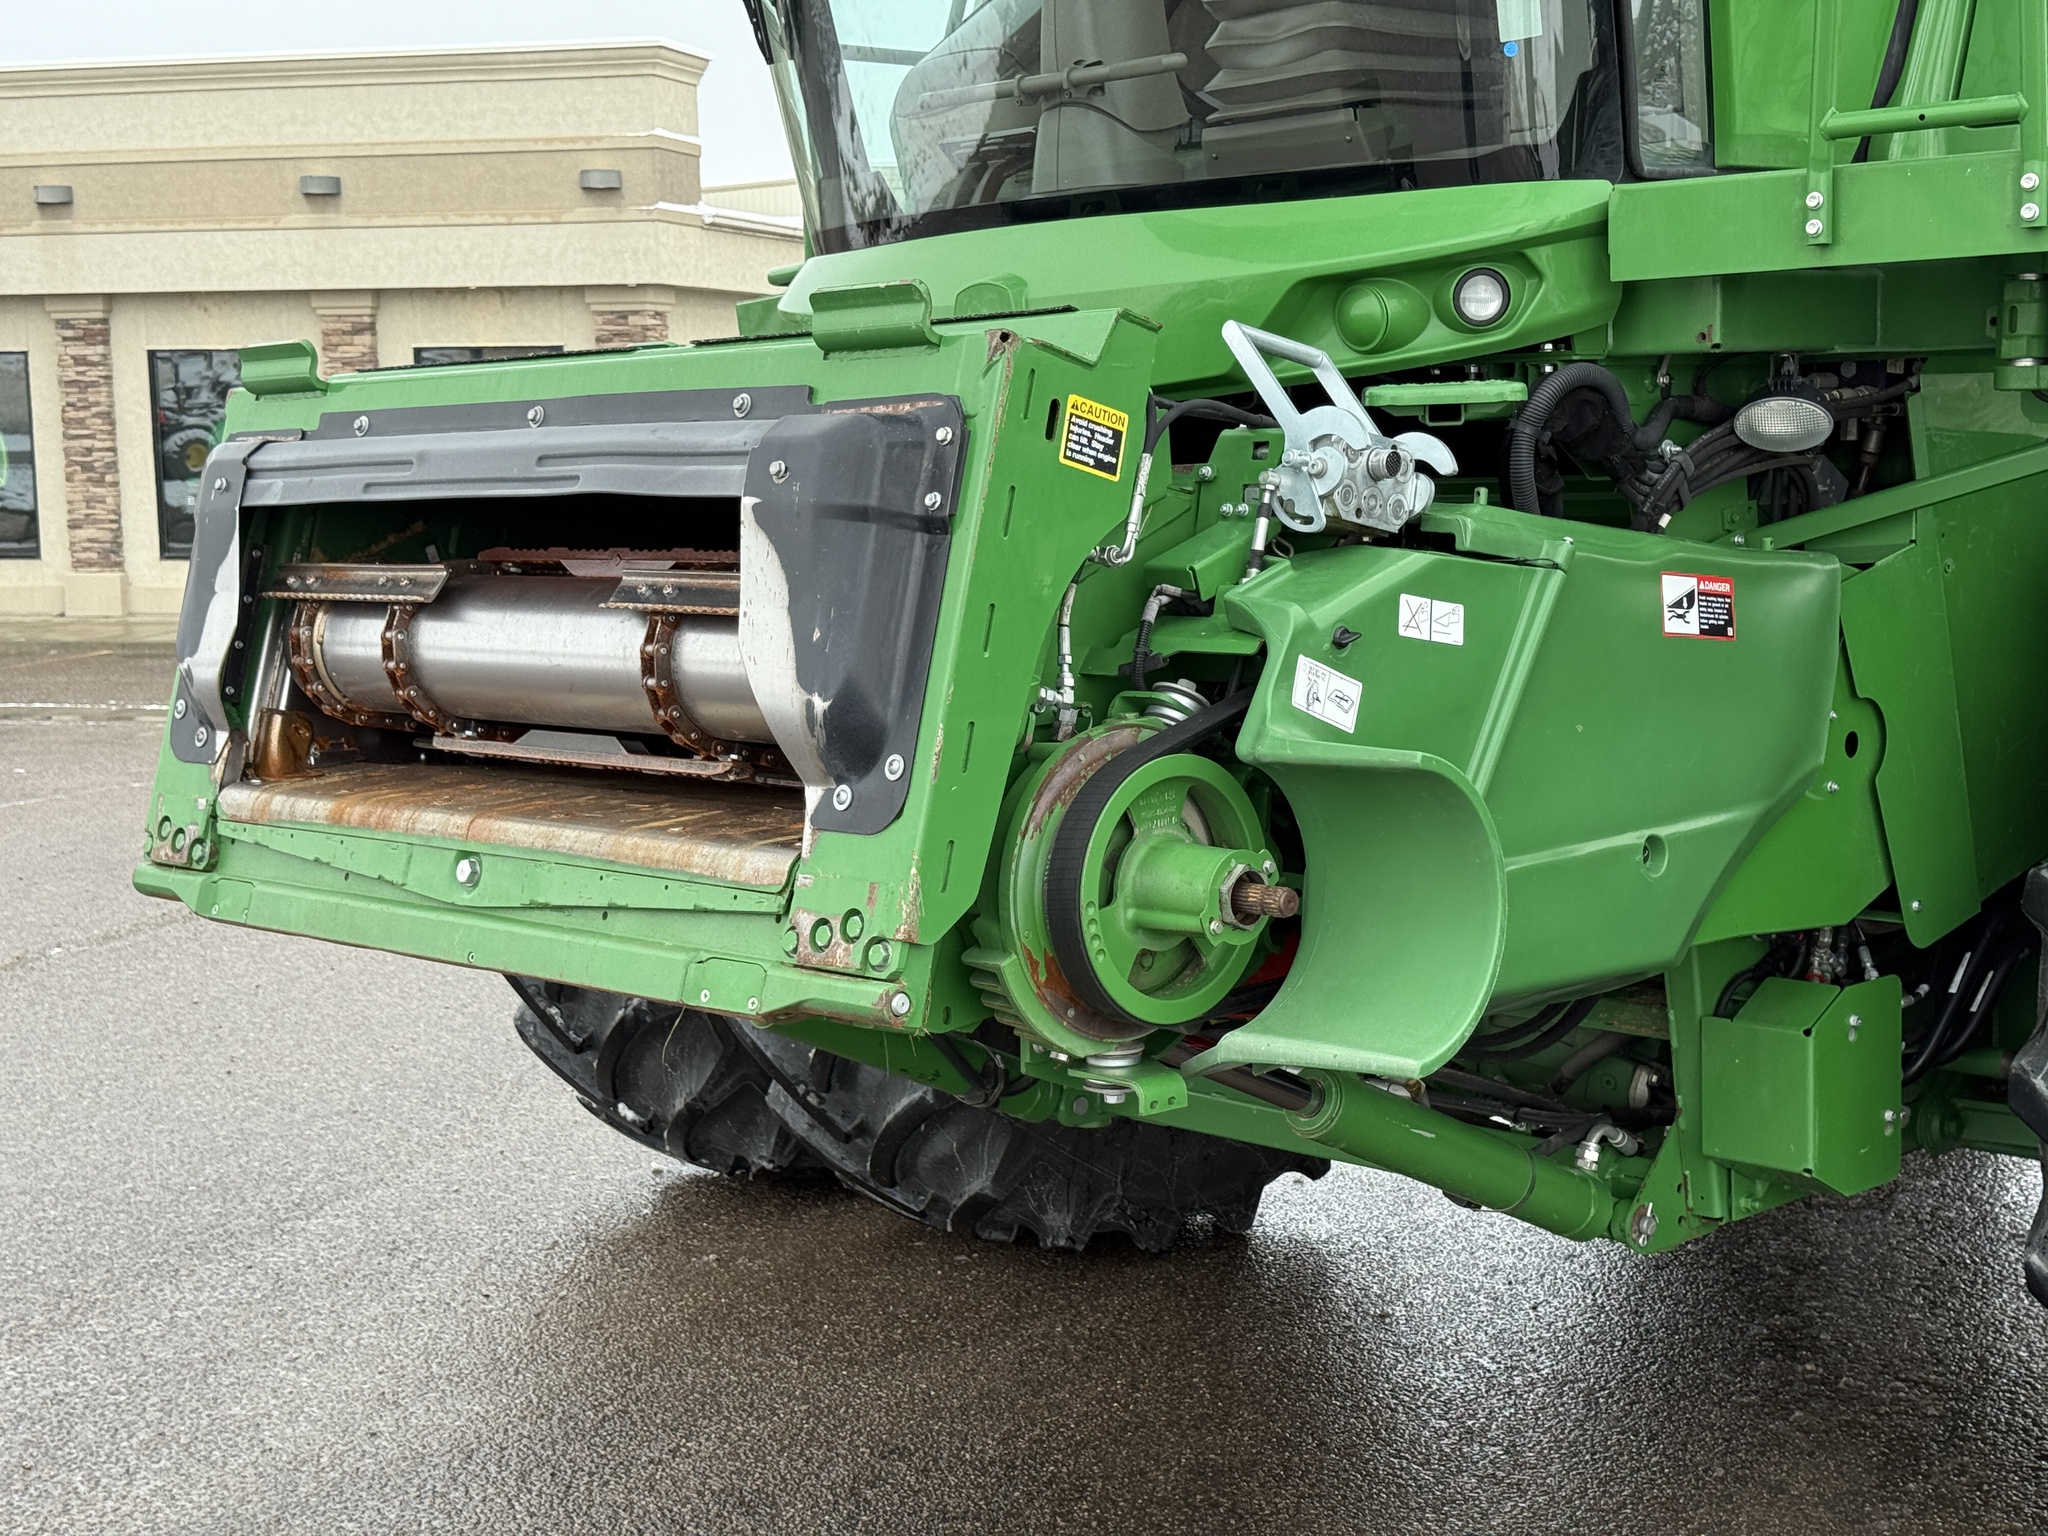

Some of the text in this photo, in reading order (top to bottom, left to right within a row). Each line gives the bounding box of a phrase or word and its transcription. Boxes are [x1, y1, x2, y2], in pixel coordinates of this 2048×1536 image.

[1080, 402, 1125, 428] CAUTION
[1071, 415, 1113, 437] Avoid crushing
[1068, 433, 1079, 441] can
[1091, 440, 1104, 452] Stay
[1094, 432, 1114, 445] Header
[1067, 441, 1116, 464] clear when engine
[1705, 581, 1730, 592] DANGER
